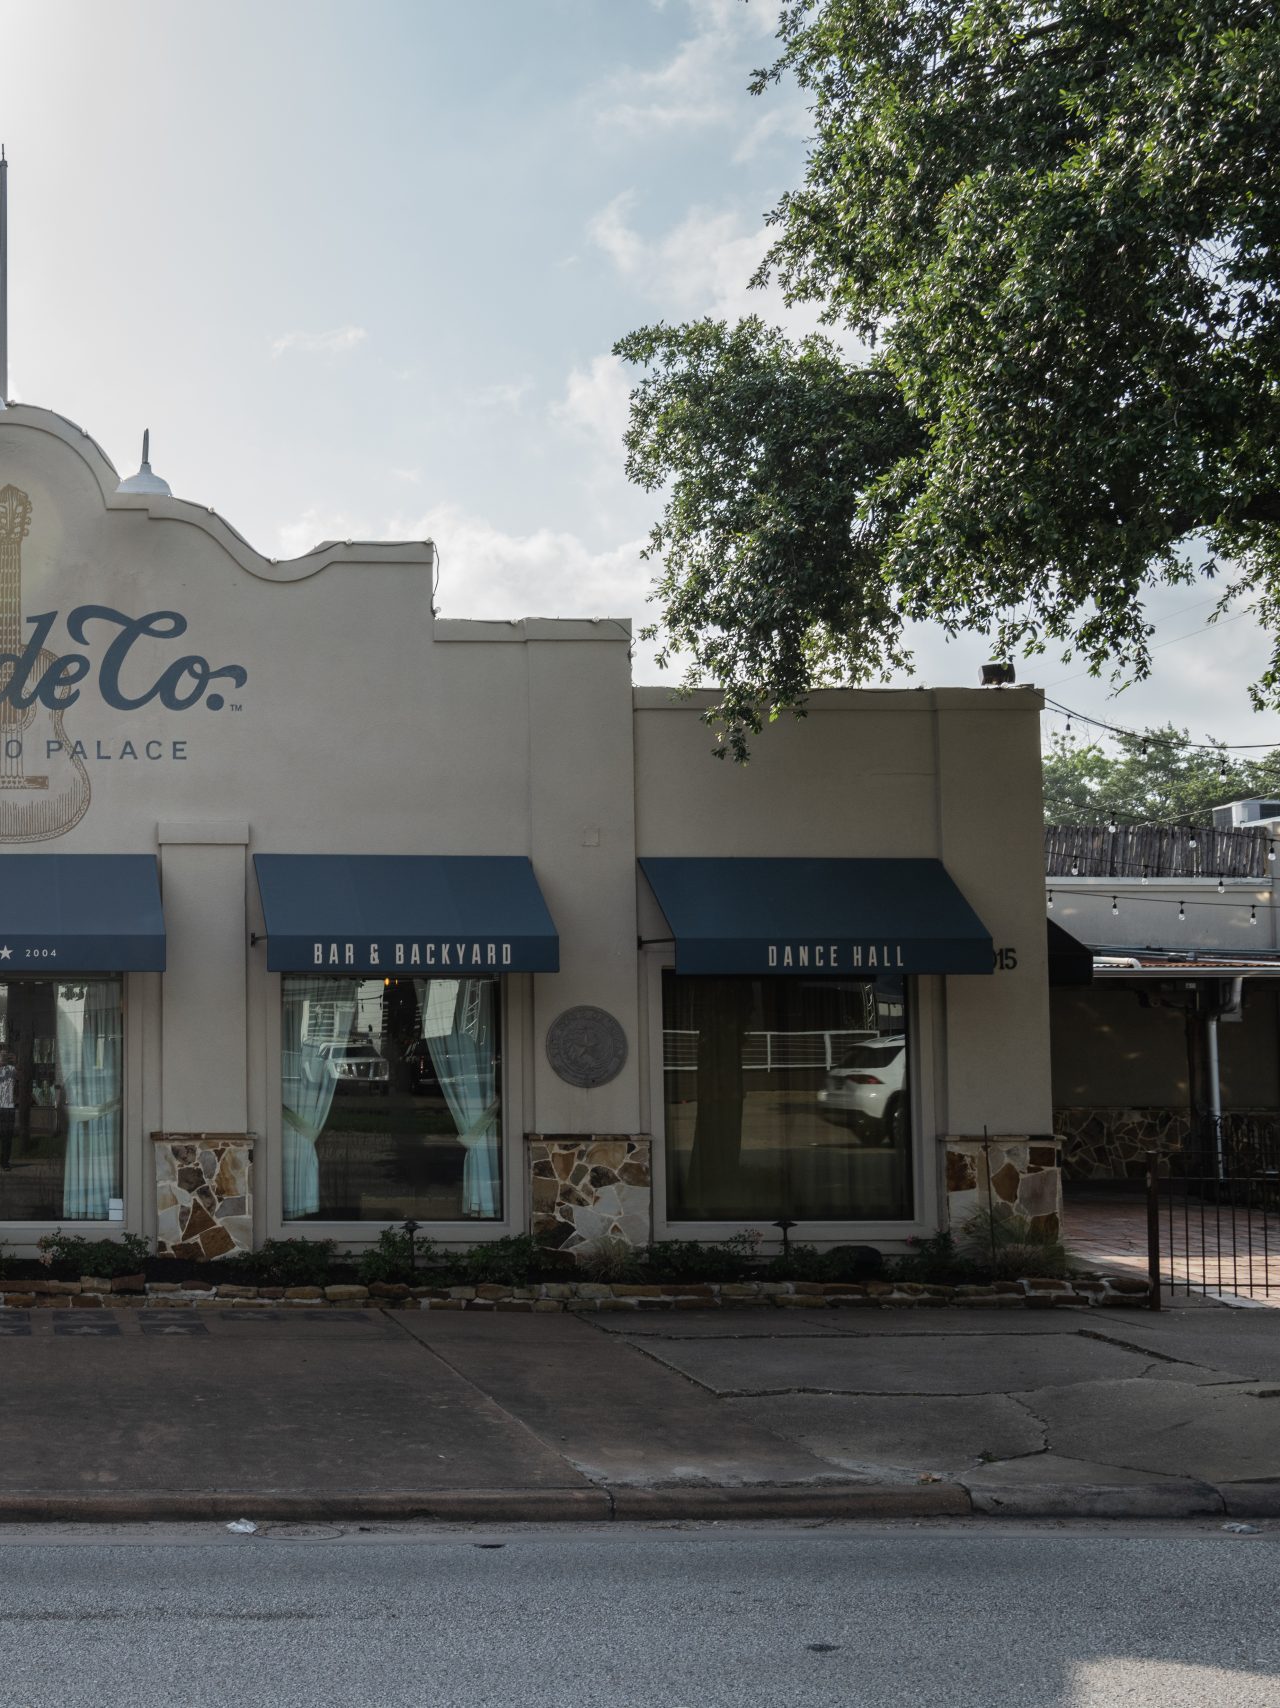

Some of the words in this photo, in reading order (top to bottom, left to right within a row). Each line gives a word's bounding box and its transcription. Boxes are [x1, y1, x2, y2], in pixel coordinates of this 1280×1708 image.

[66, 604, 248, 711] Co.
[230, 704, 243, 712] TM
[46, 740, 189, 761] PALACE
[25, 949, 57, 958] 2004
[313, 943, 354, 964] BAR
[370, 943, 380, 965] &
[395, 943, 511, 965] BACKYARD
[768, 945, 839, 967] DANCE
[853, 945, 904, 967] HALL
